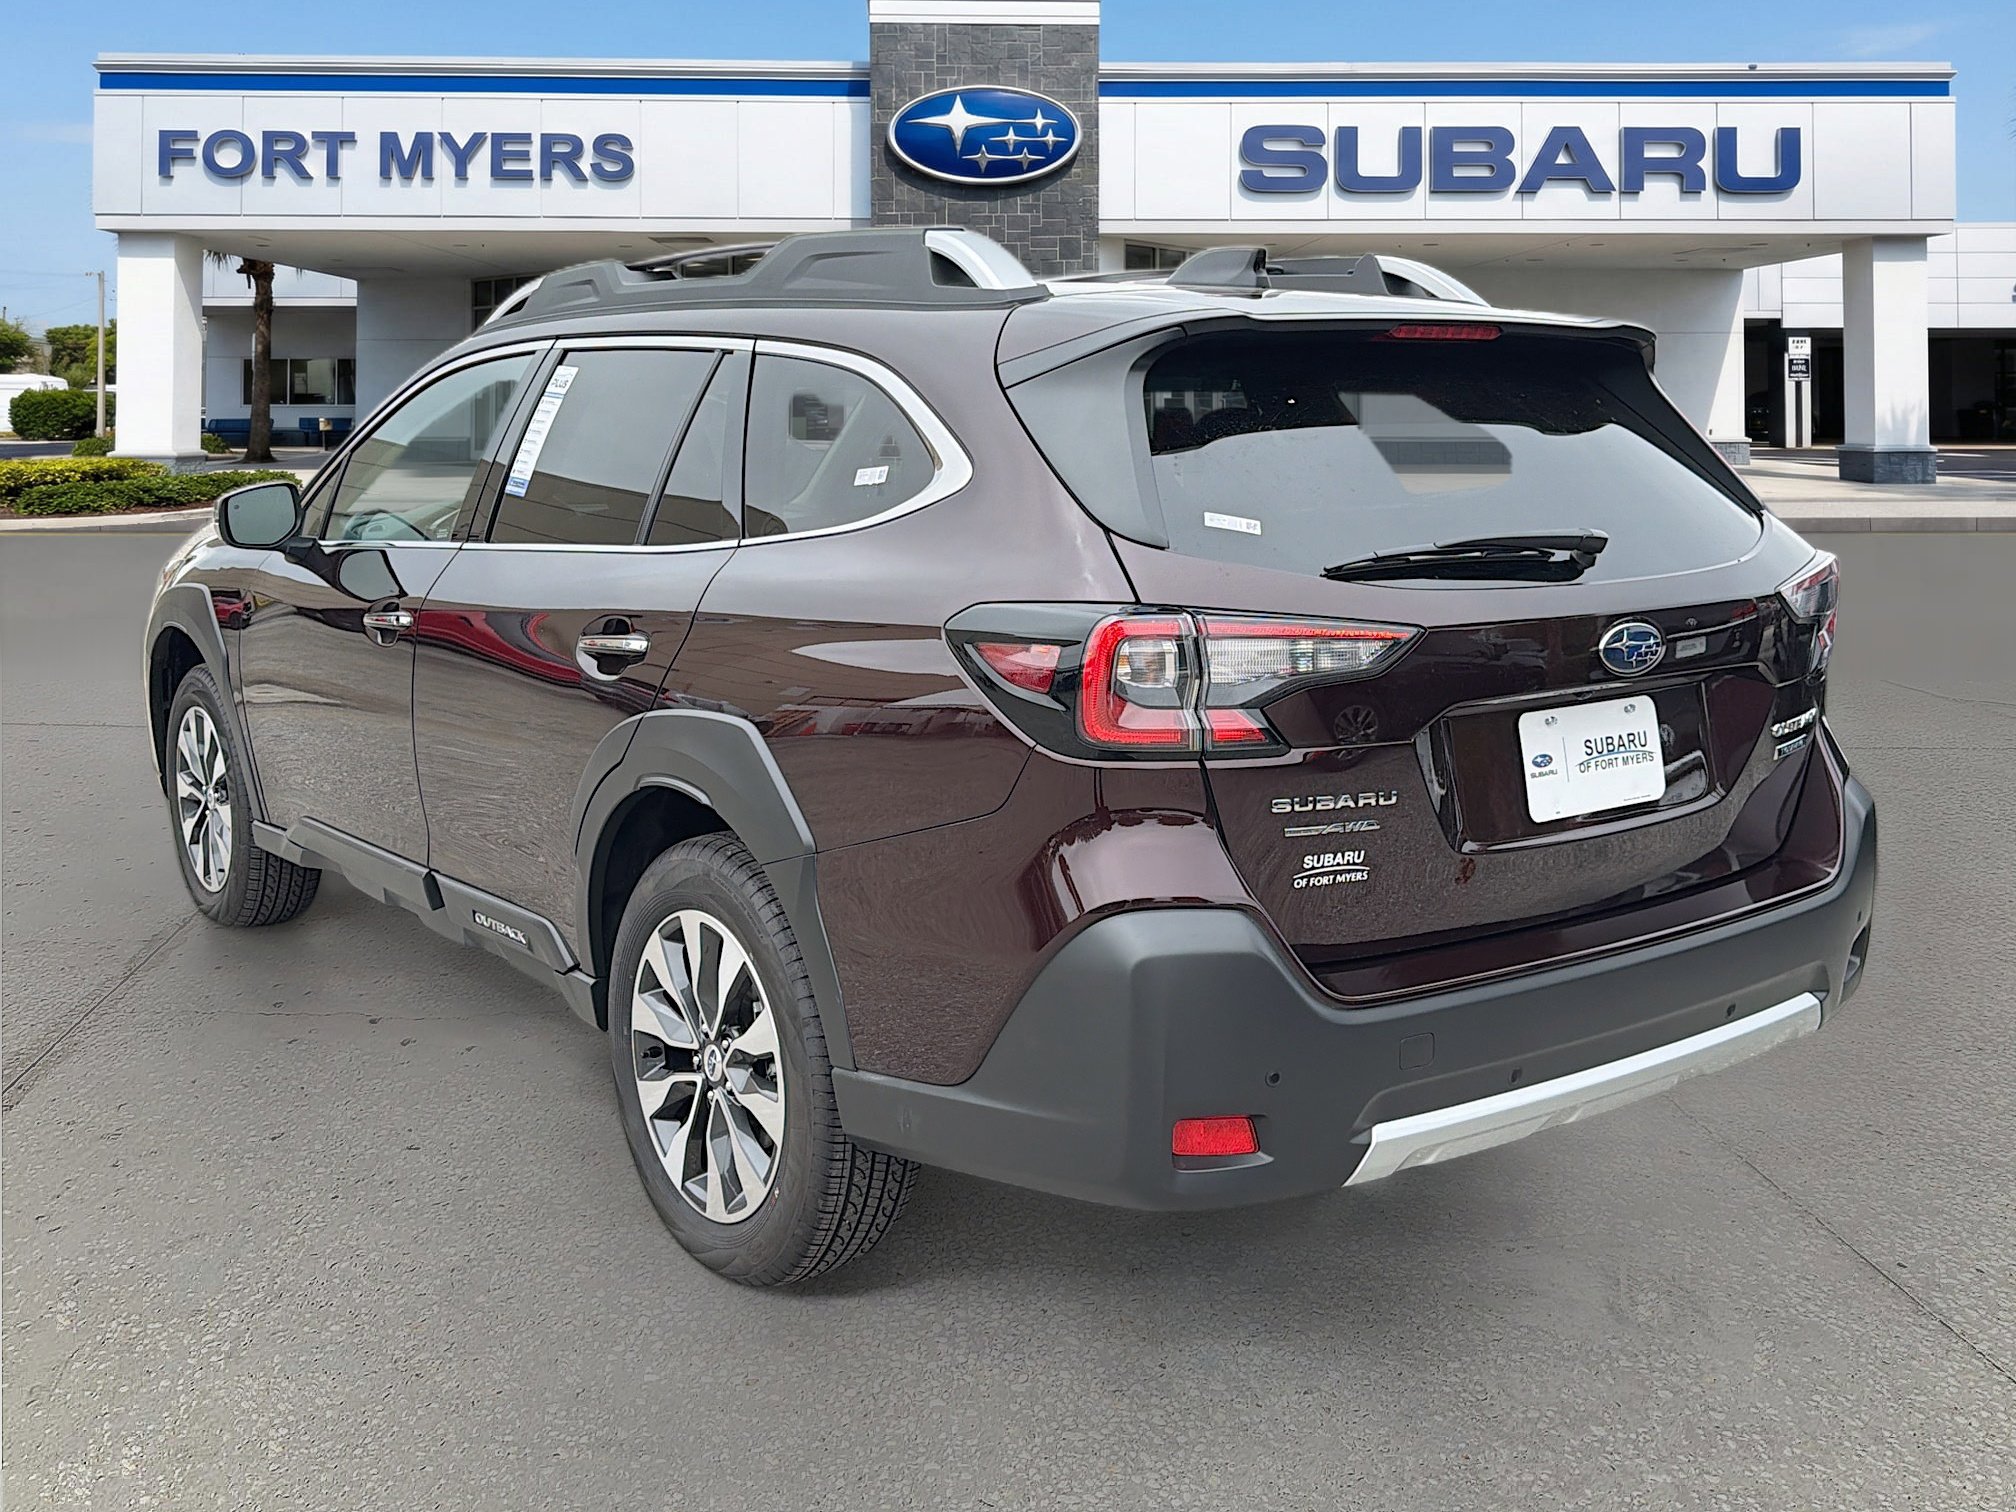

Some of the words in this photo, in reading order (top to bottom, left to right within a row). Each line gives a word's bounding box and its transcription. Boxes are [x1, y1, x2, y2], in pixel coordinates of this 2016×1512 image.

[158, 129, 355, 180] FORT
[379, 130, 635, 183] MYERS
[1239, 124, 1803, 197] SUBARU
[1584, 731, 1647, 756] SUBARU
[1530, 769, 1558, 779] SUBARU
[1579, 763, 1592, 774] OF
[1595, 758, 1619, 771] FORT
[1622, 752, 1655, 767] MYERS
[1271, 790, 1398, 813] SUBARU
[1303, 850, 1365, 869] SUBARU
[1293, 878, 1308, 889] OF
[1309, 875, 1334, 887] FORT
[1336, 871, 1368, 883] MYERS
[475, 913, 526, 944] OUTBACK
